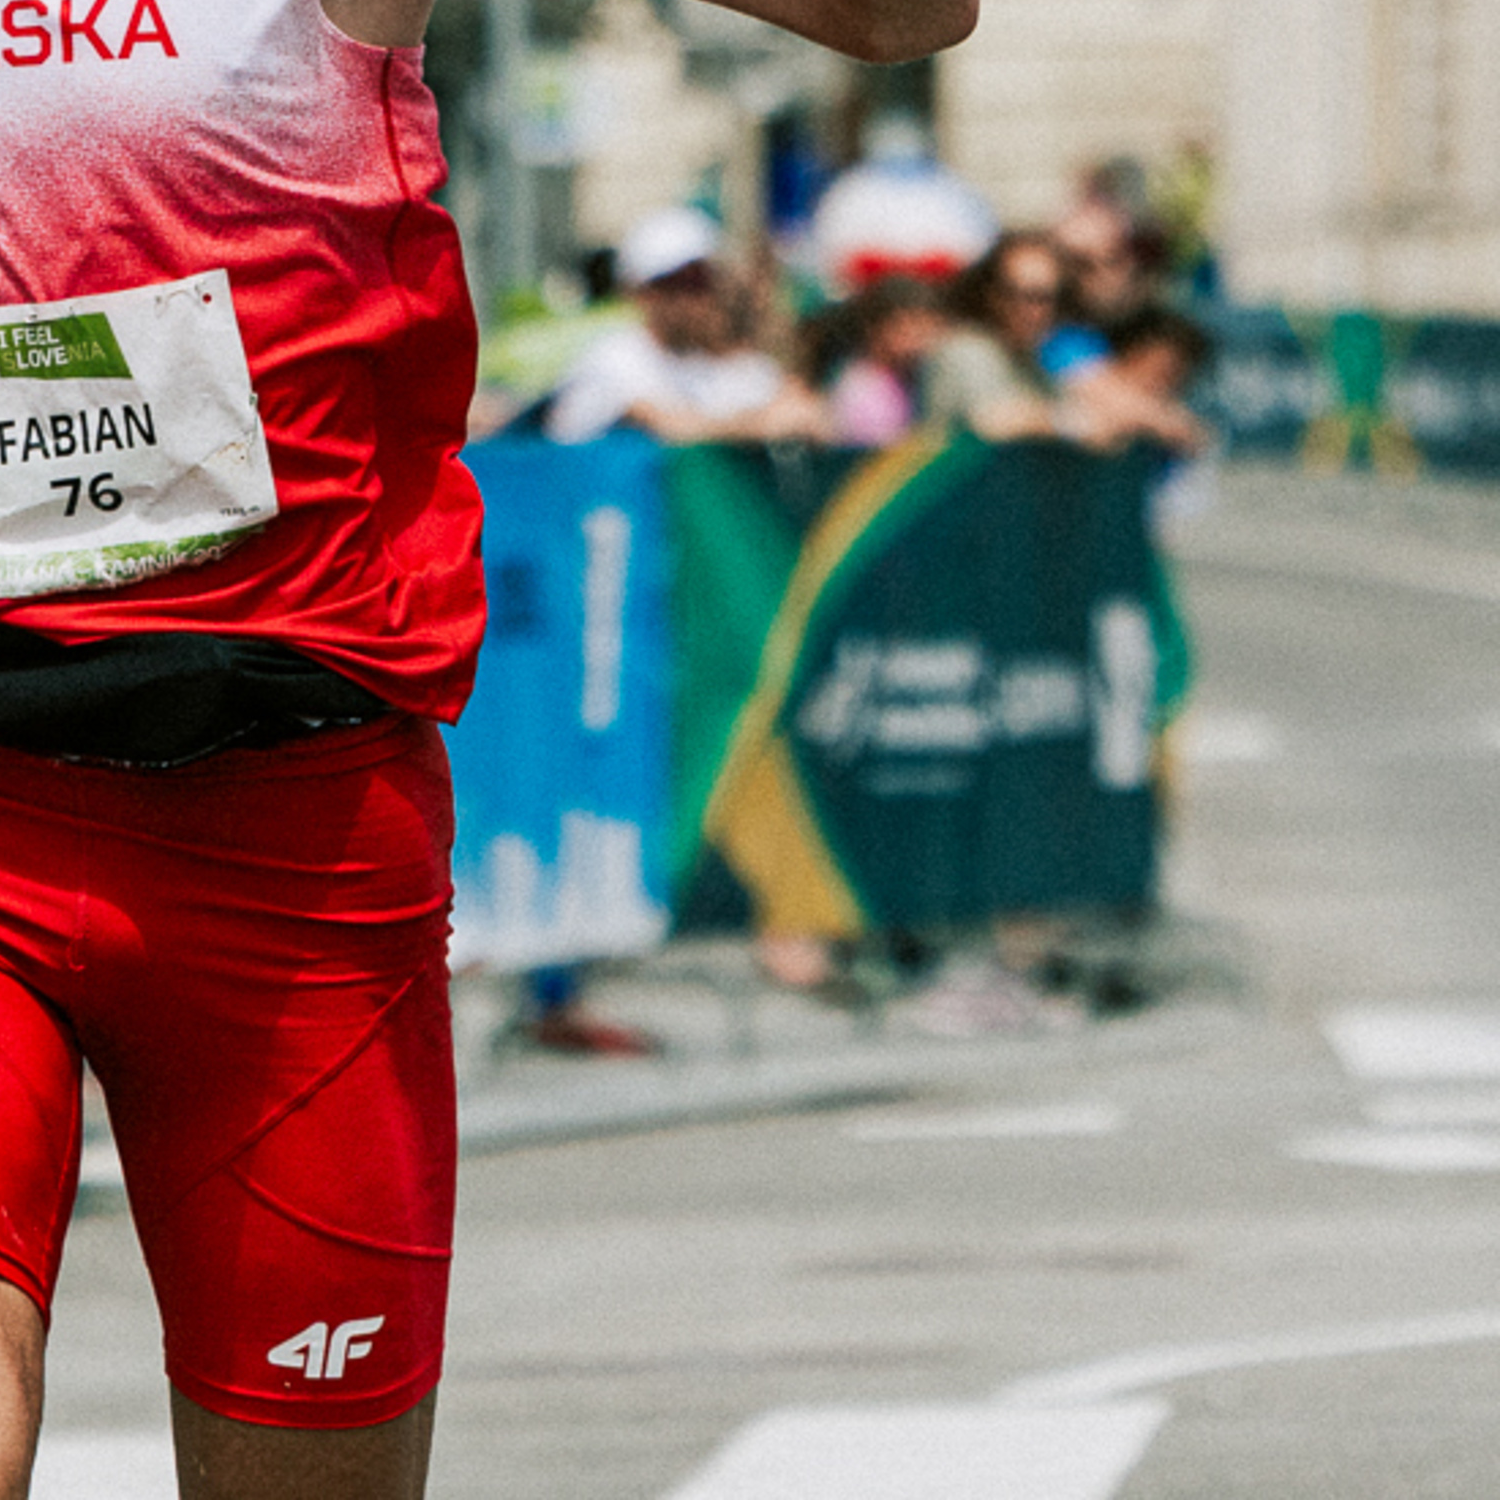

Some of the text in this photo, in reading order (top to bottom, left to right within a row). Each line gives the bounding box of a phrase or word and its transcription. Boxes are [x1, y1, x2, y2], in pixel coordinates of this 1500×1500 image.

[1, 340, 106, 371] SLOVENIA
[11, 325, 60, 348] FEEL
[49, 471, 124, 516] 76
[266, 1314, 386, 1380] 4F
